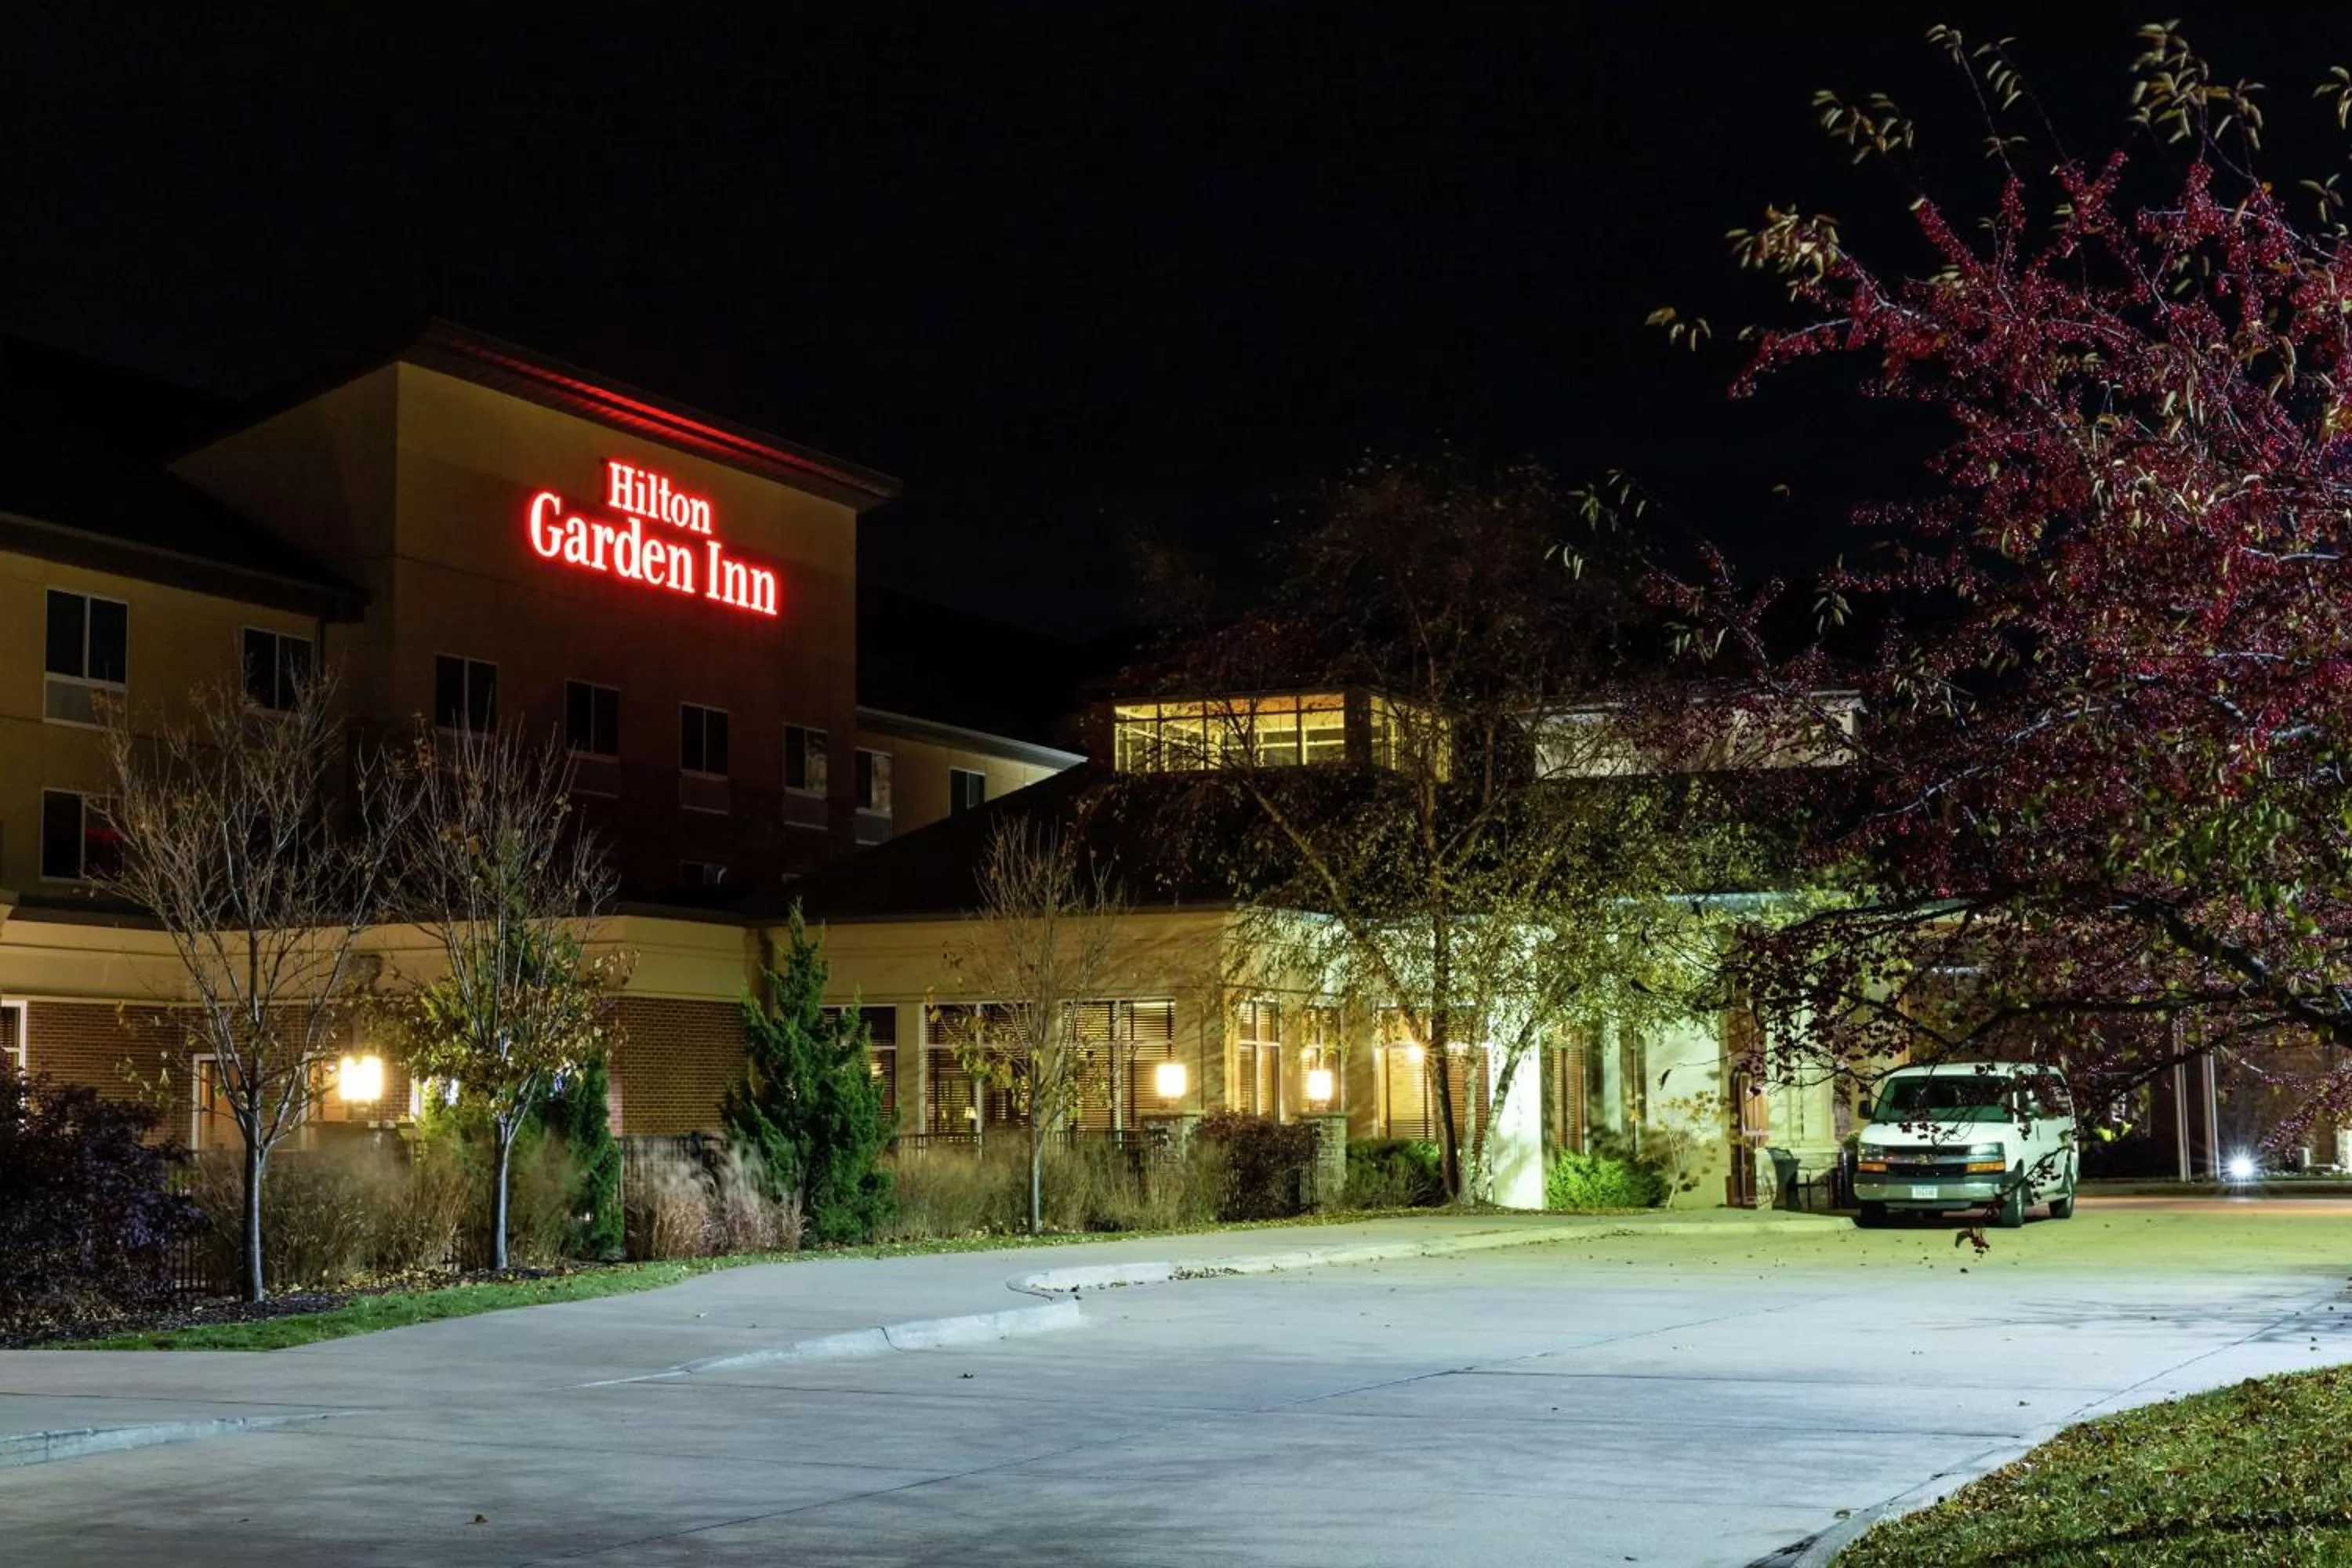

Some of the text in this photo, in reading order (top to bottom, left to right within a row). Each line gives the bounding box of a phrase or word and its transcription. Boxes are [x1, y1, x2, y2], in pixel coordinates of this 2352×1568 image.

[608, 461, 712, 535] Hilton
[530, 492, 778, 615] Garden Inn
